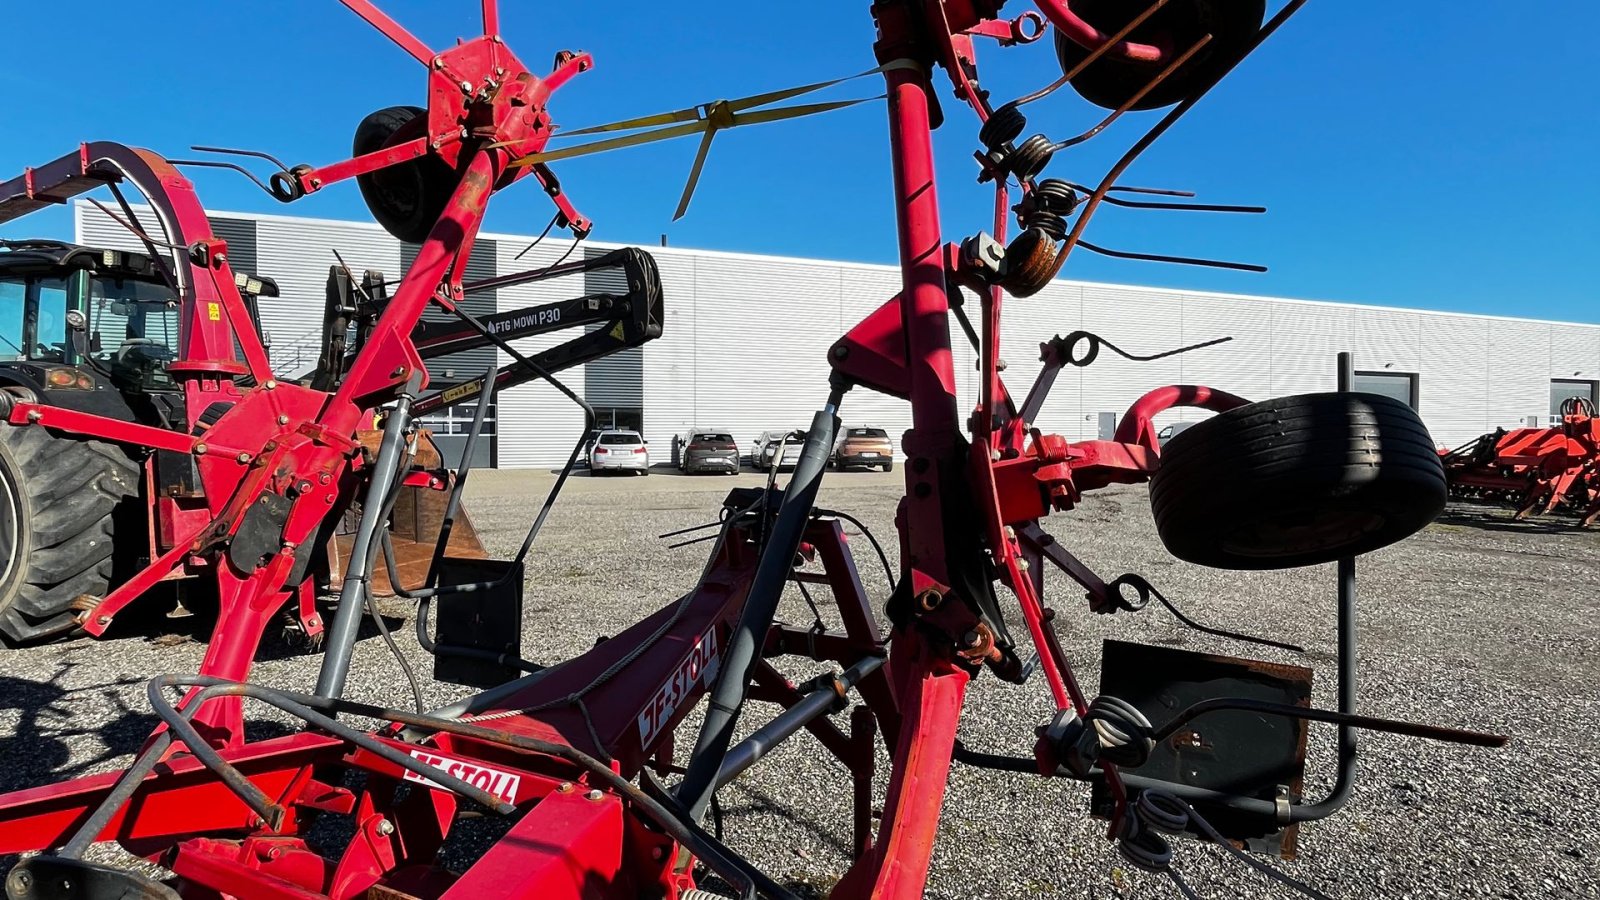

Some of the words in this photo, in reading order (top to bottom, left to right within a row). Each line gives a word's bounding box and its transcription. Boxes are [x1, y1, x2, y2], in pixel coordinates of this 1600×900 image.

[495, 320, 511, 333] FTG
[513, 315, 538, 328] MOWI
[539, 308, 561, 325] P30
[642, 627, 718, 743] JF-STOLL
[406, 753, 516, 803] JFSTOLL
